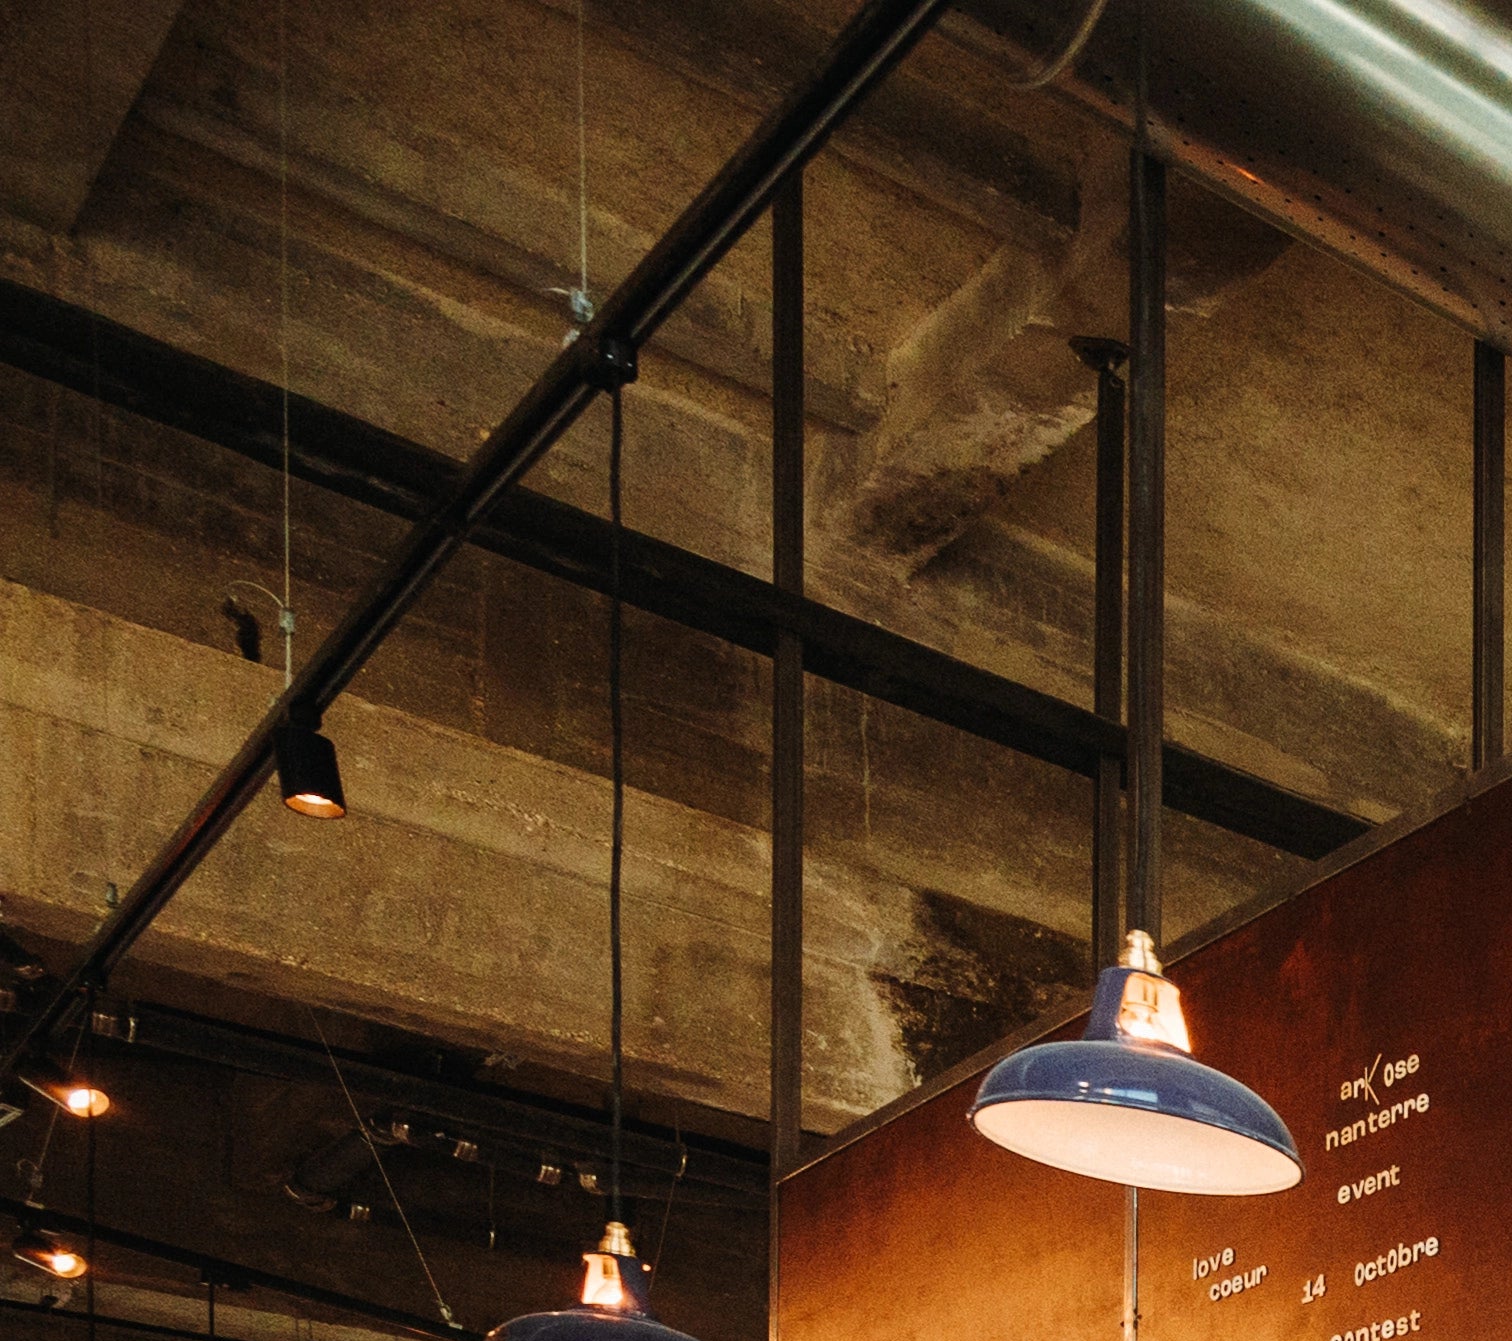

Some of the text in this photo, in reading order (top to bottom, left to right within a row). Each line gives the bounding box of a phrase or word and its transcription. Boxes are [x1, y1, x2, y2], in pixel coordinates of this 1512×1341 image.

[1325, 1091, 1431, 1151] nanterre
[1337, 1163, 1401, 1205] event
[1192, 1246, 1236, 1282] love
[1208, 1263, 1268, 1302] coeur
[1301, 1274, 1327, 1305] 14
